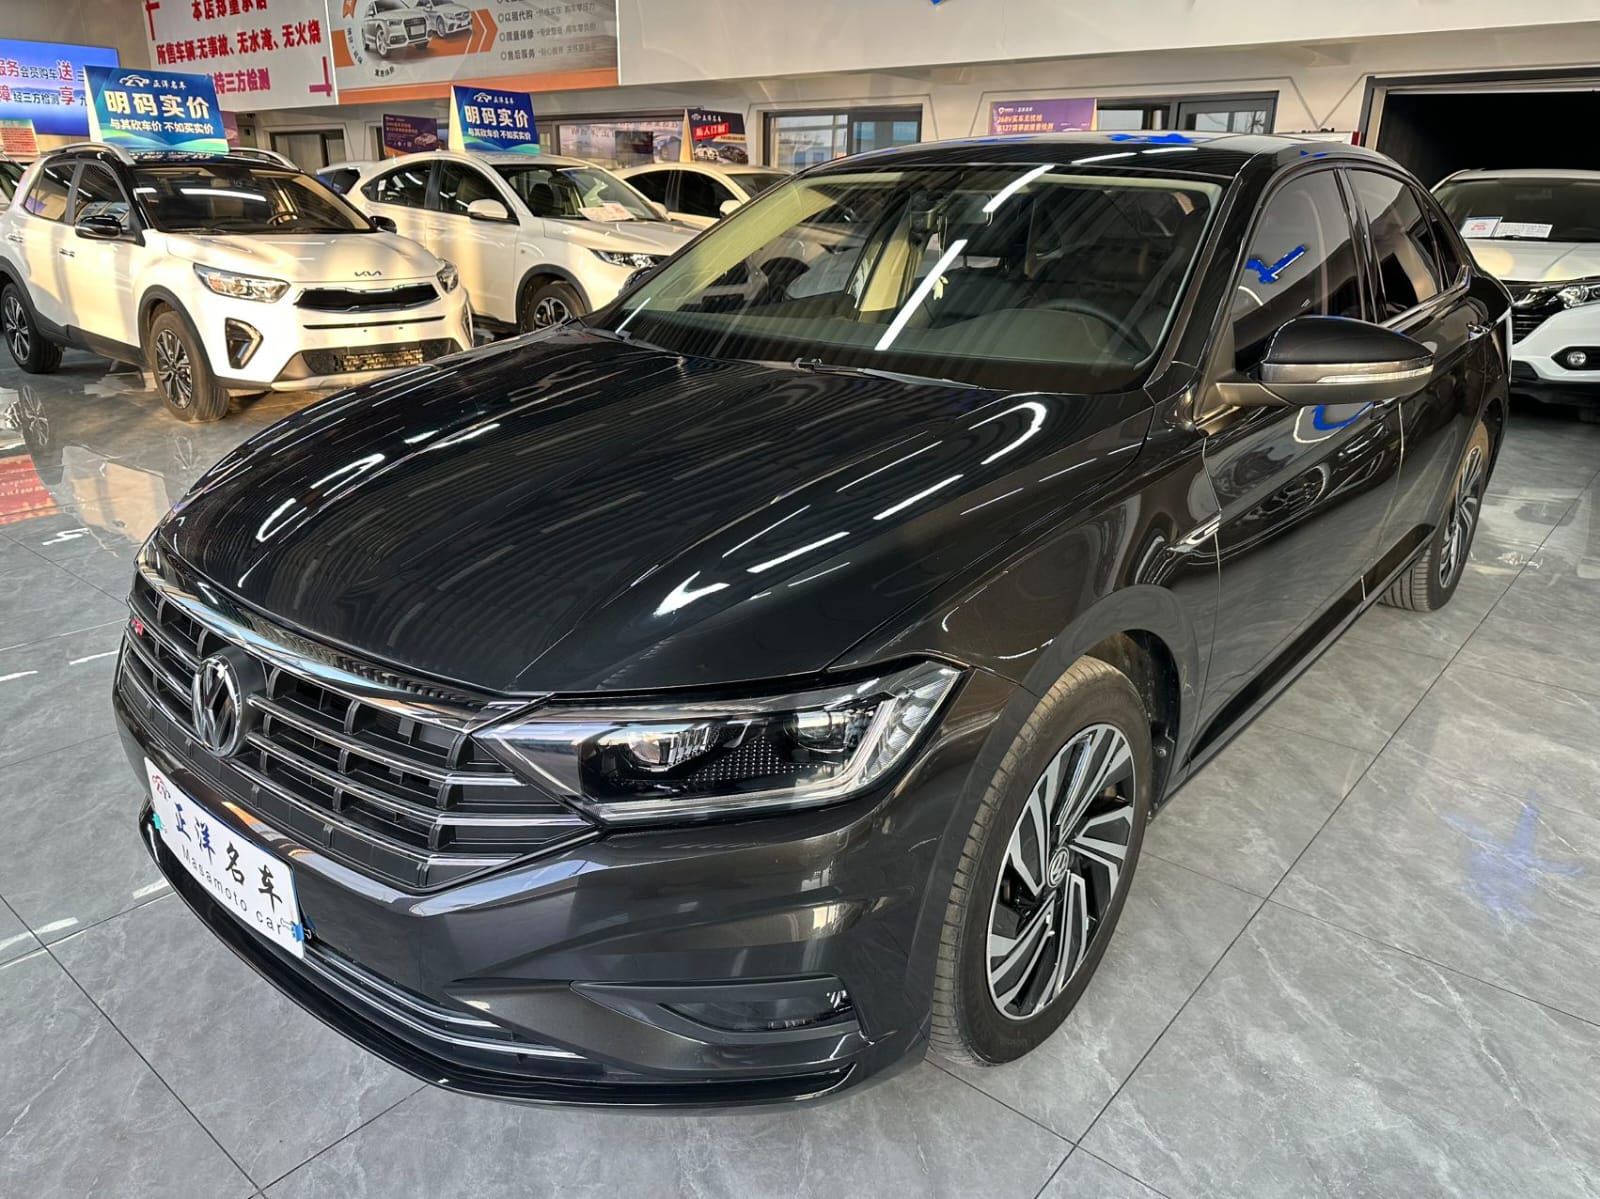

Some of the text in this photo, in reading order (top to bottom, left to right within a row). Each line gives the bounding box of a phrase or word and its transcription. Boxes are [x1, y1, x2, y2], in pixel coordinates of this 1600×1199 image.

[209, 68, 270, 94] 持三方检测
[103, 90, 210, 119] 明码实价
[464, 105, 528, 128] 明码实价
[182, 844, 282, 934] Masamoto car
